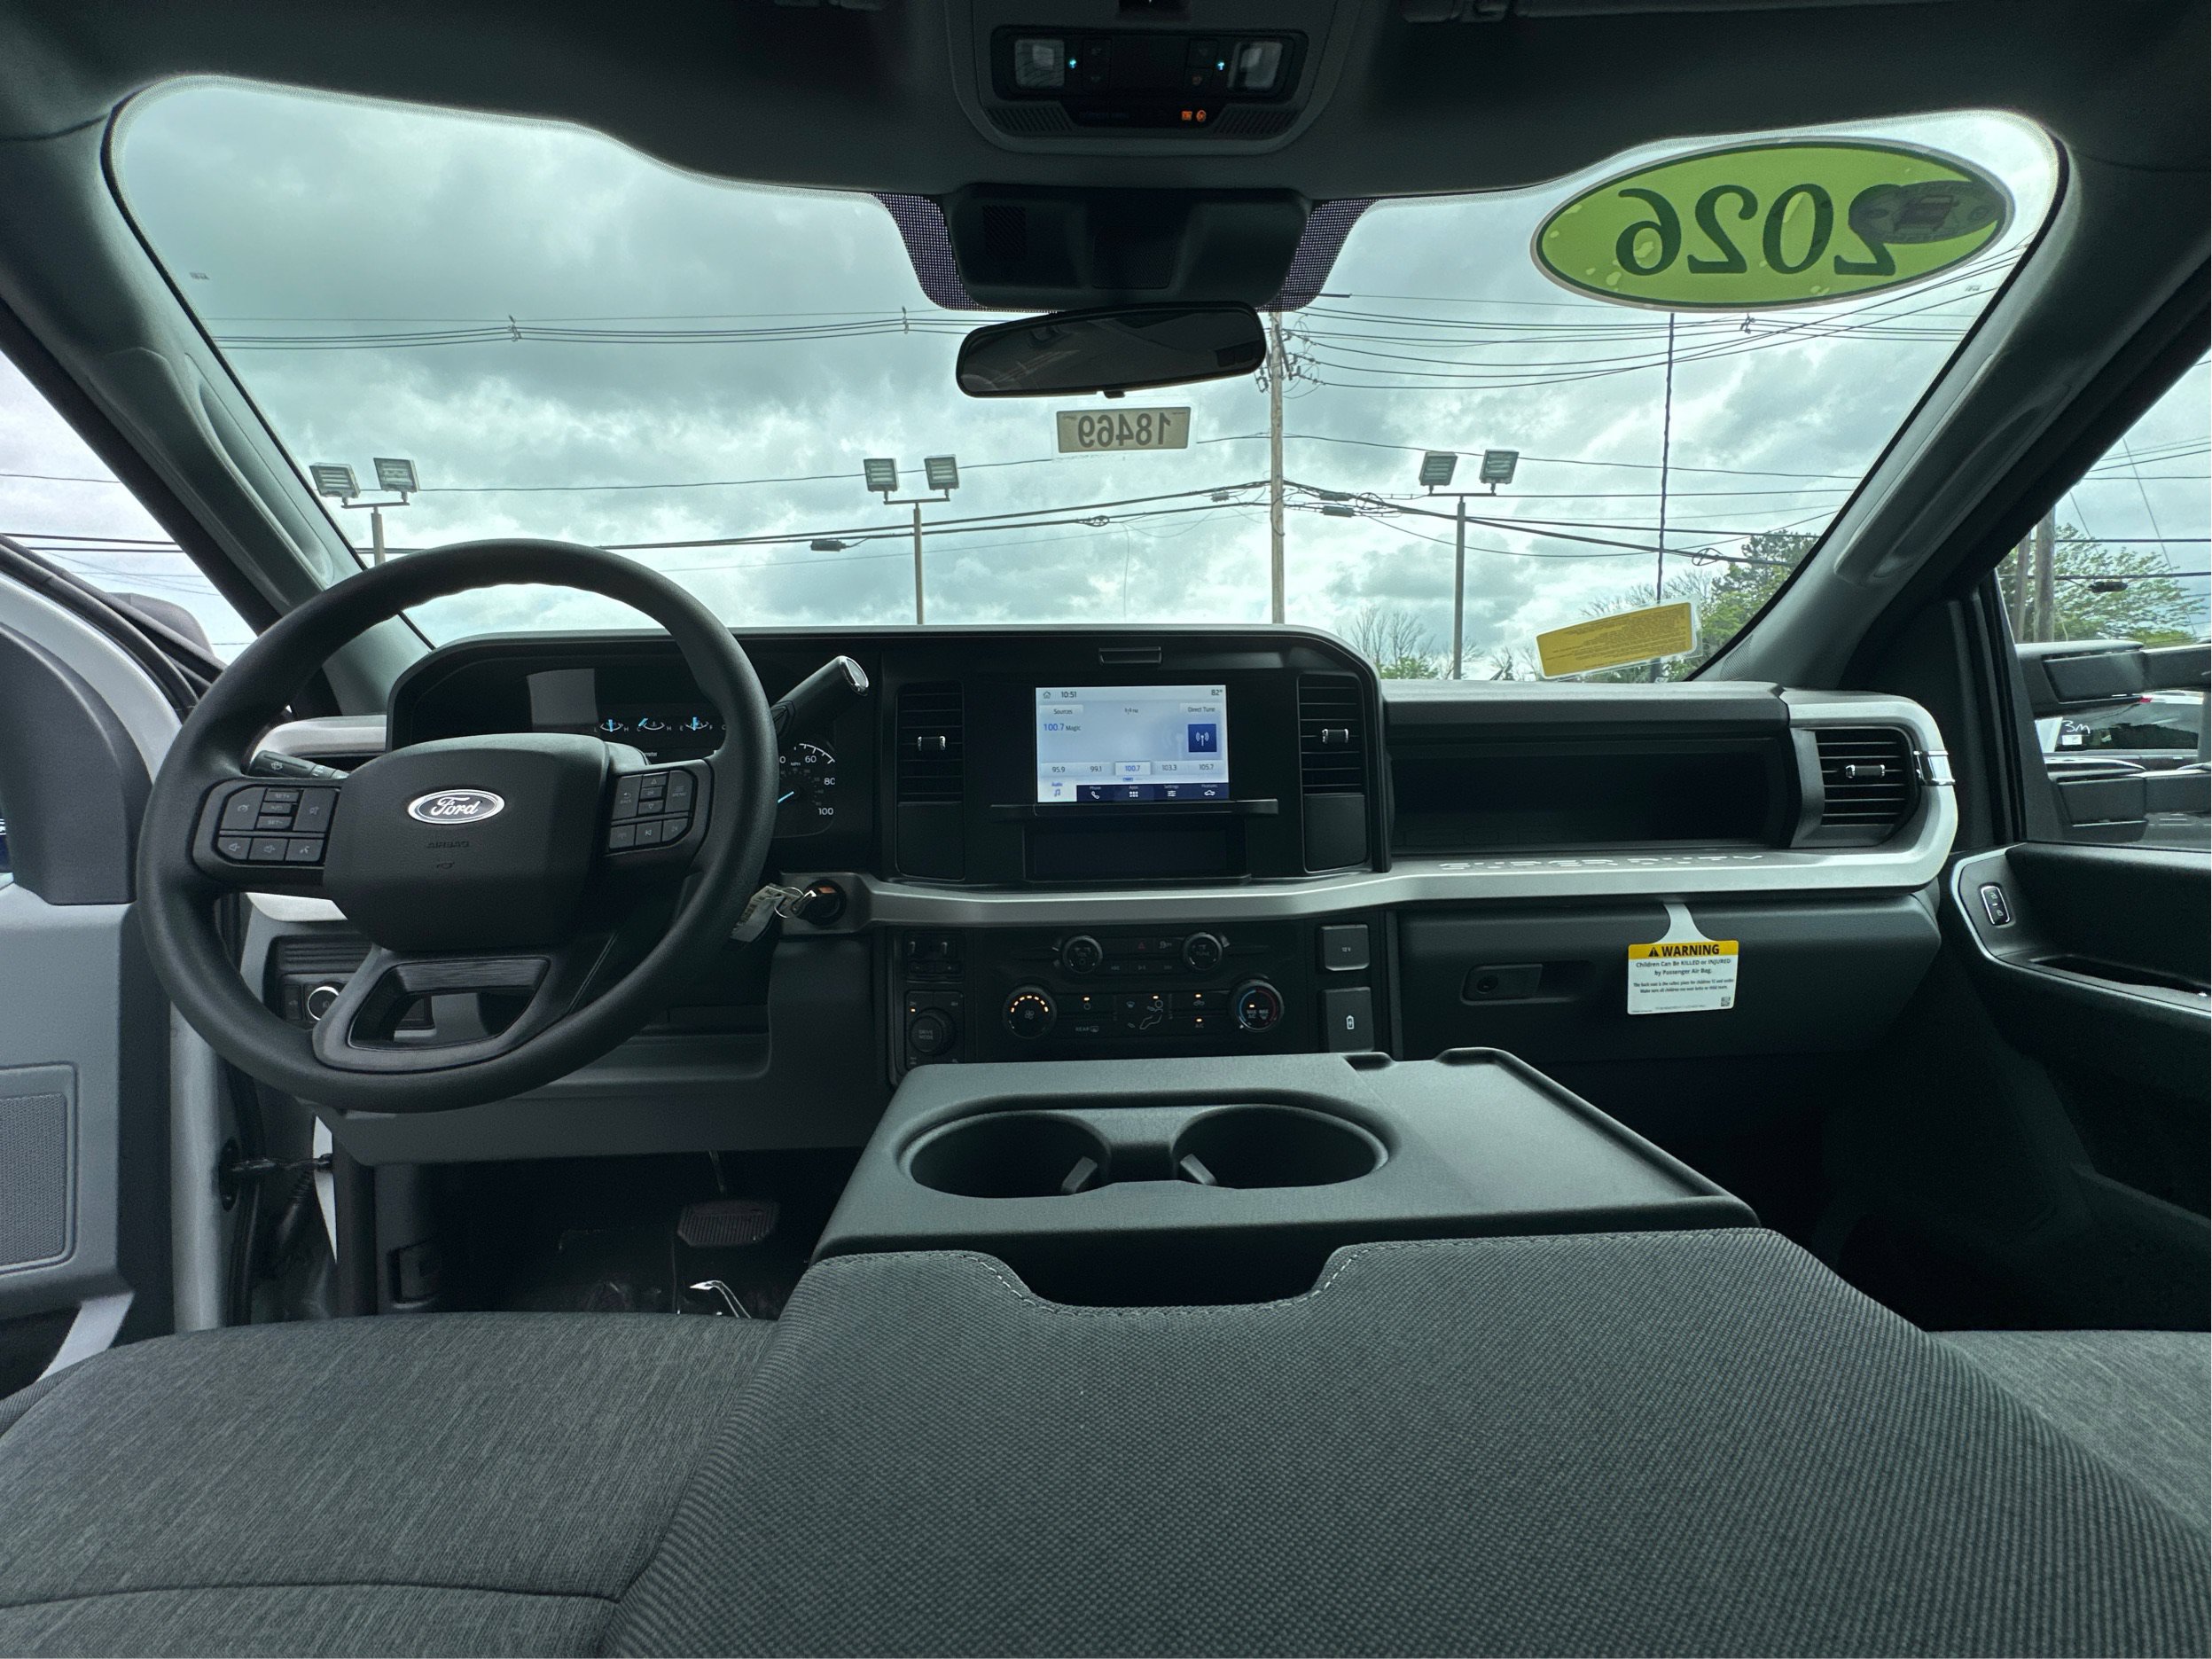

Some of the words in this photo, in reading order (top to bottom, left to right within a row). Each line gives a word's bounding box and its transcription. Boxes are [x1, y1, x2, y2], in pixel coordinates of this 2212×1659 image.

[1043, 724, 1065, 732] 100.7
[804, 755, 817, 764] 60
[823, 777, 836, 786] 80
[430, 796, 482, 817] Ford
[818, 807, 834, 816] 100
[1439, 859, 1619, 870] SUPER
[1627, 855, 1763, 865] DUTY
[1661, 944, 1720, 957] WARNING
